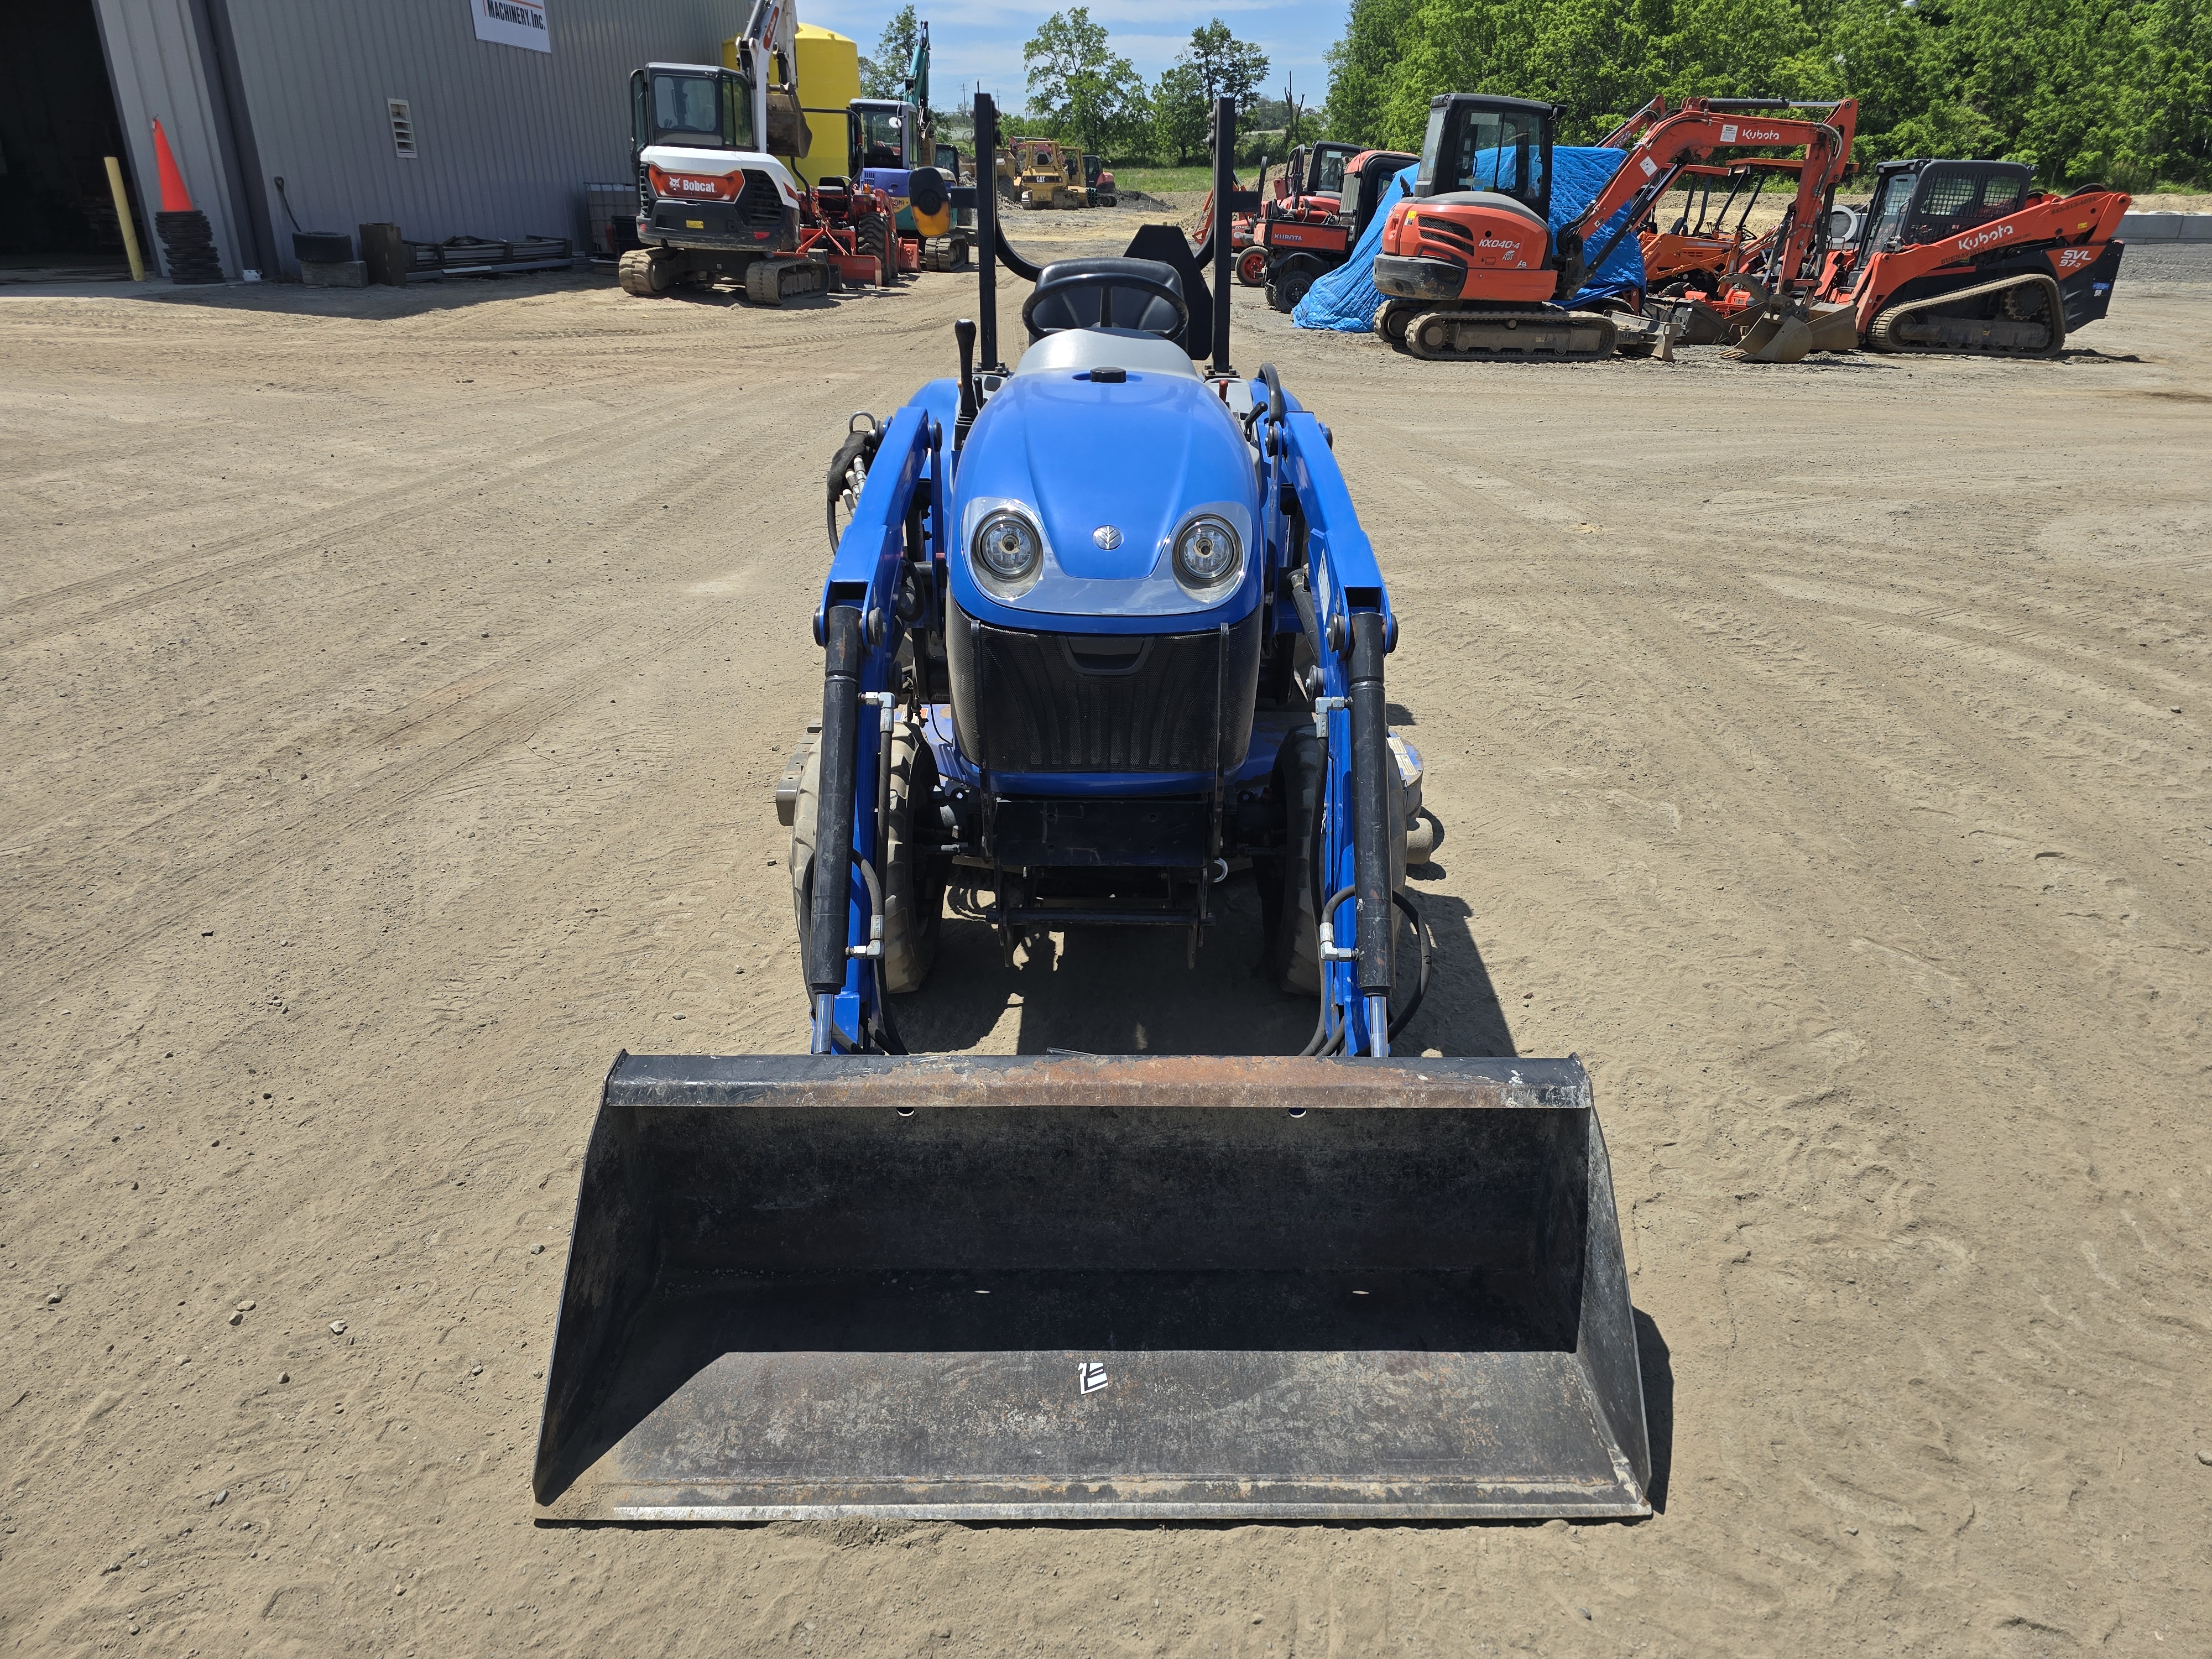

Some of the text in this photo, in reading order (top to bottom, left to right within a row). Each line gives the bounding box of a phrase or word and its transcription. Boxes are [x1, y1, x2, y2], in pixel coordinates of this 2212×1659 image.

[530, 9, 546, 30] Inc.
[1742, 129, 1780, 140] Kubota
[683, 180, 715, 193] Bobcat
[1479, 239, 1520, 249] KX040-4
[1958, 225, 2013, 250] Kubota
[1940, 246, 1986, 264] BUENAVISTA
[2061, 249, 2091, 260] SVL
